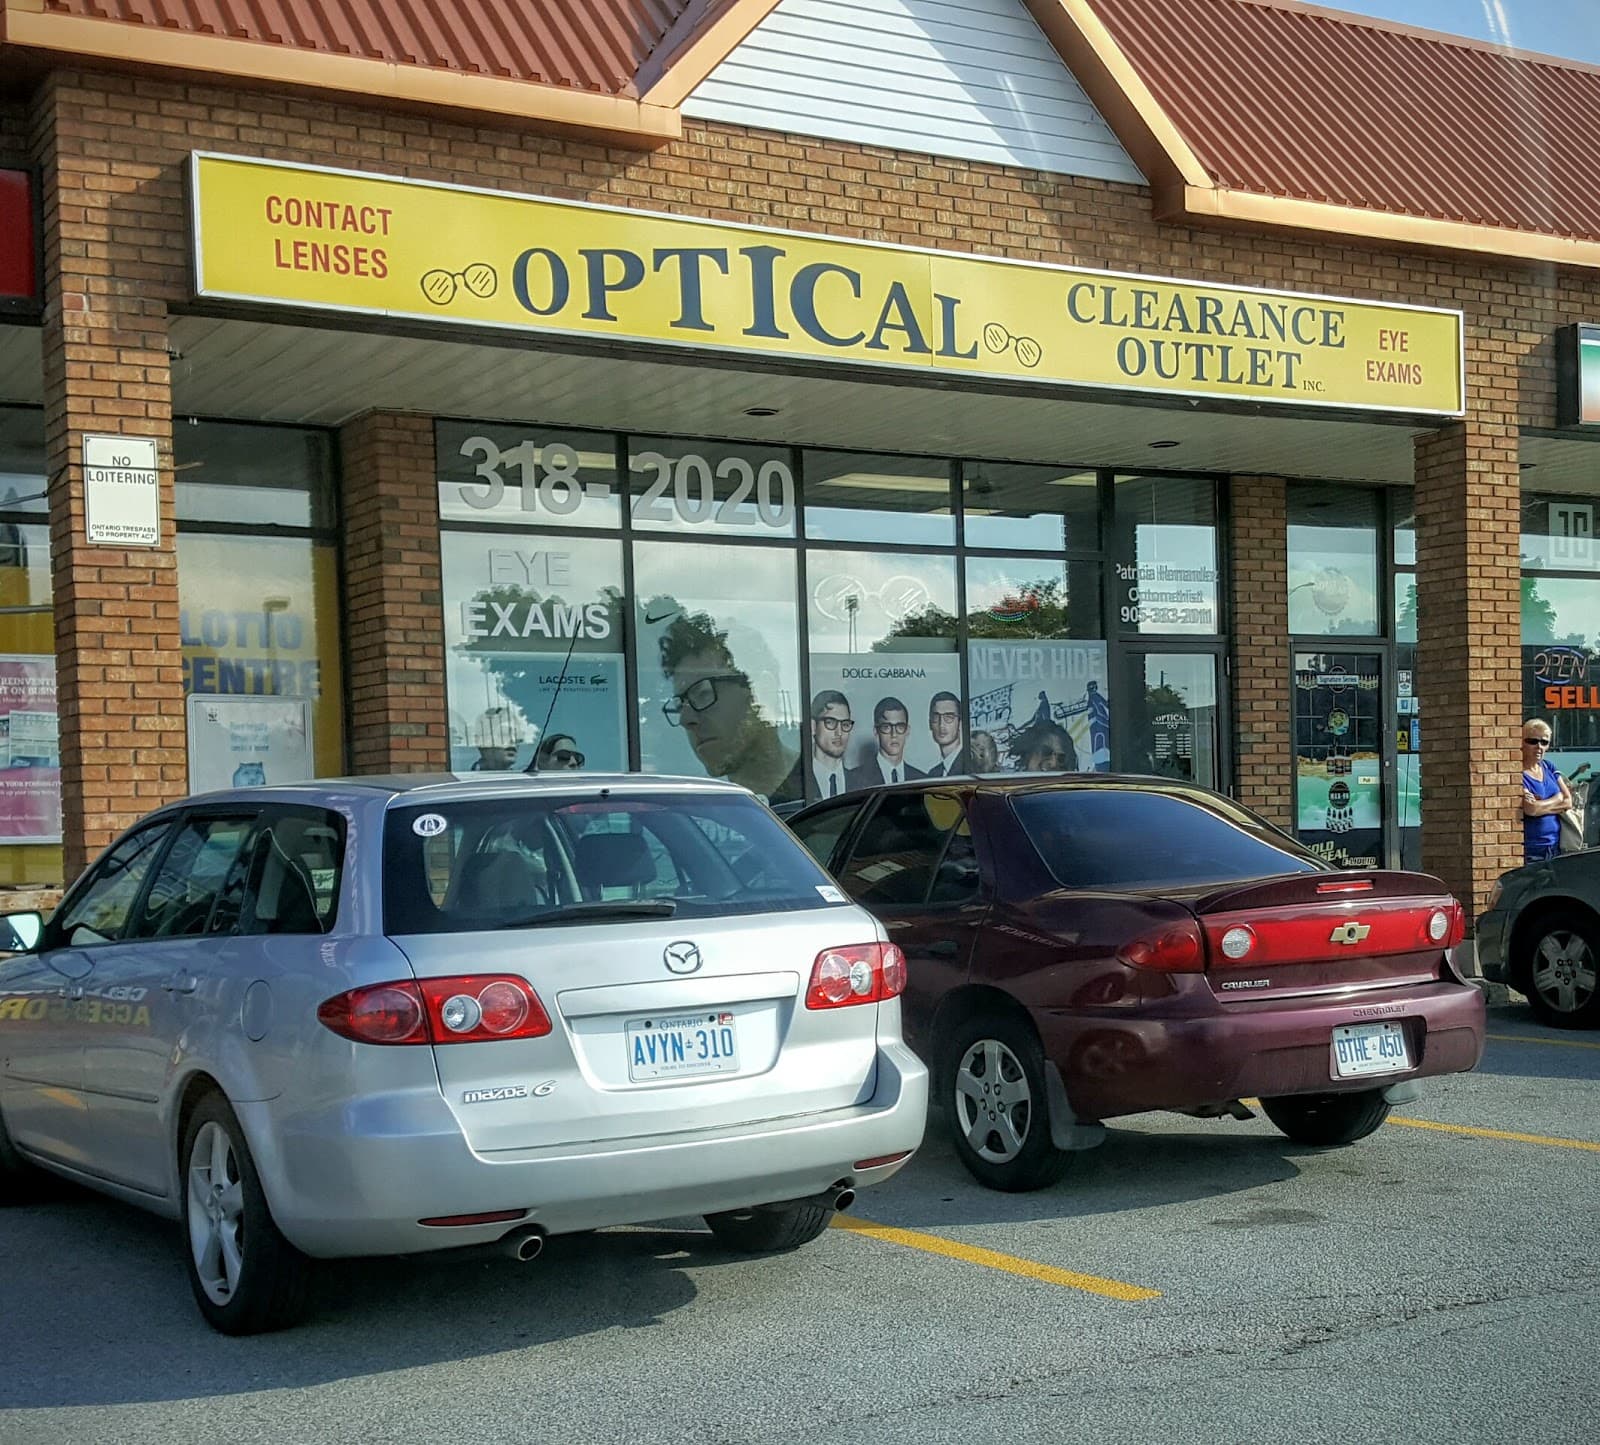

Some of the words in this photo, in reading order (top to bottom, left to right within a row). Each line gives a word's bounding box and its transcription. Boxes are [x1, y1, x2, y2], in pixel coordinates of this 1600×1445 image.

[266, 195, 393, 236] CONTACT
[274, 239, 389, 279] LENSES
[512, 245, 978, 359] OPTICAL
[1067, 283, 1346, 348] CLEARANCE
[1379, 329, 1409, 353] EYE
[1116, 336, 1302, 389] OUTLET
[1366, 360, 1422, 386] EXAMS
[1302, 379, 1326, 393] INC.
[112, 456, 131, 467] NO
[88, 470, 155, 485] LOITERING
[122, 525, 156, 533] TRESPASS
[488, 548, 570, 587] EYE
[181, 609, 304, 649] LOTTO
[460, 600, 611, 639] EXAMS
[842, 668, 873, 678] DOLCE
[878, 668, 927, 679] GABBANA
[970, 647, 1044, 680] NEVER
[1051, 647, 1103, 680] HIDE
[1534, 653, 1588, 680] OPEN
[538, 675, 586, 685] LACOSTE
[1545, 686, 1600, 709] SELL
[1222, 979, 1270, 990] CAVALIER
[660, 1018, 703, 1030] ONTARIO
[1352, 1005, 1406, 1017] CHEVROLET
[634, 1031, 685, 1066] AVYN
[695, 1028, 734, 1059] 310
[1337, 1036, 1373, 1064] BTHE
[1379, 1033, 1404, 1059] 450
[532, 1080, 557, 1098] 6
